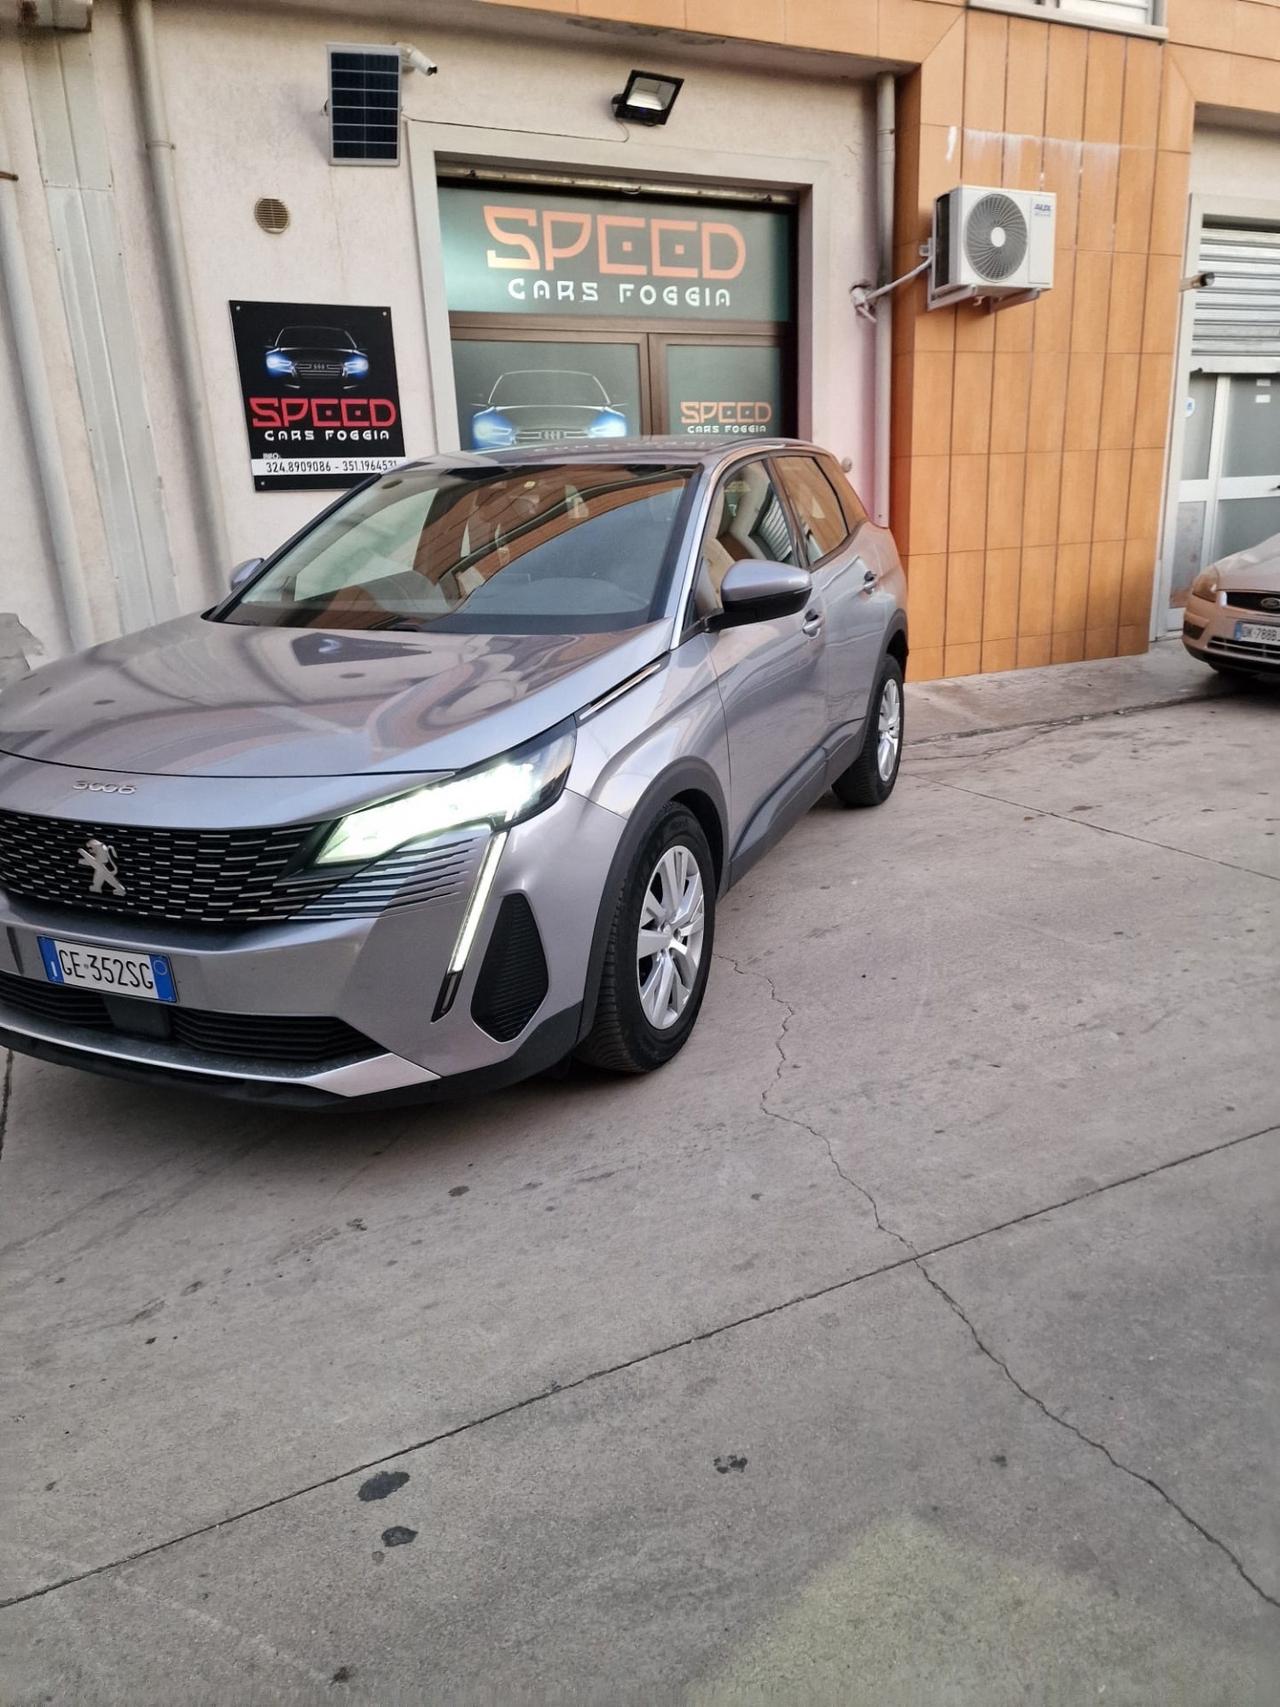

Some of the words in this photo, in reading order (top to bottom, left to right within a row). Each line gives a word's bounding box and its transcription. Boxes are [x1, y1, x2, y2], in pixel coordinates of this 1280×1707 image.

[483, 205, 747, 280] SPEED
[508, 277, 599, 302] CARS
[618, 283, 731, 307] FOGGIA
[249, 397, 397, 427] SPEED
[680, 401, 772, 424] SPEED
[264, 429, 315, 441] CARS
[325, 429, 390, 441] FOGGIA
[687, 425, 720, 434] CARS
[724, 424, 767, 434] FOGGIA
[265, 461, 332, 473] 324.8909086
